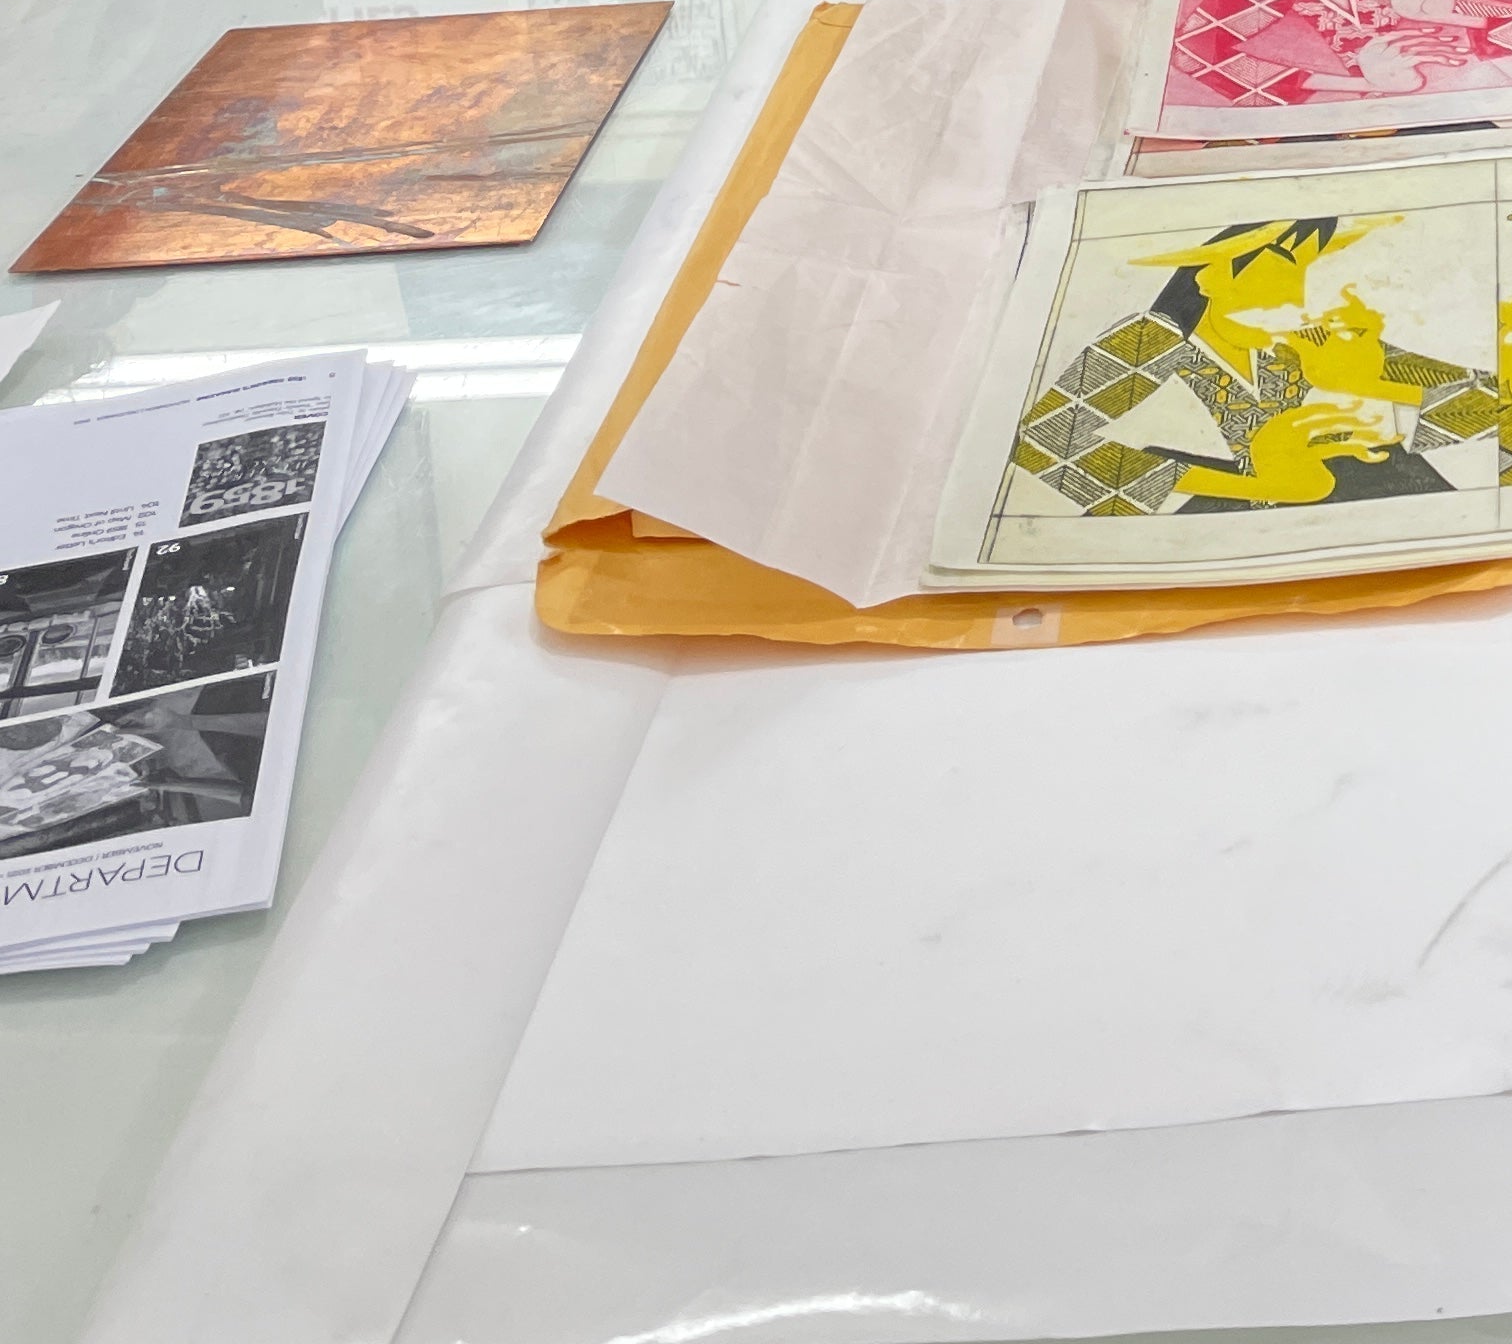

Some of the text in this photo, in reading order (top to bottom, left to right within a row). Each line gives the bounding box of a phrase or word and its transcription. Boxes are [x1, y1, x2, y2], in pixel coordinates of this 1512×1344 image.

[190, 476, 305, 517] 1859
[156, 542, 181, 555] 92
[33, 841, 163, 873] NOVEMBER DECEMBER
